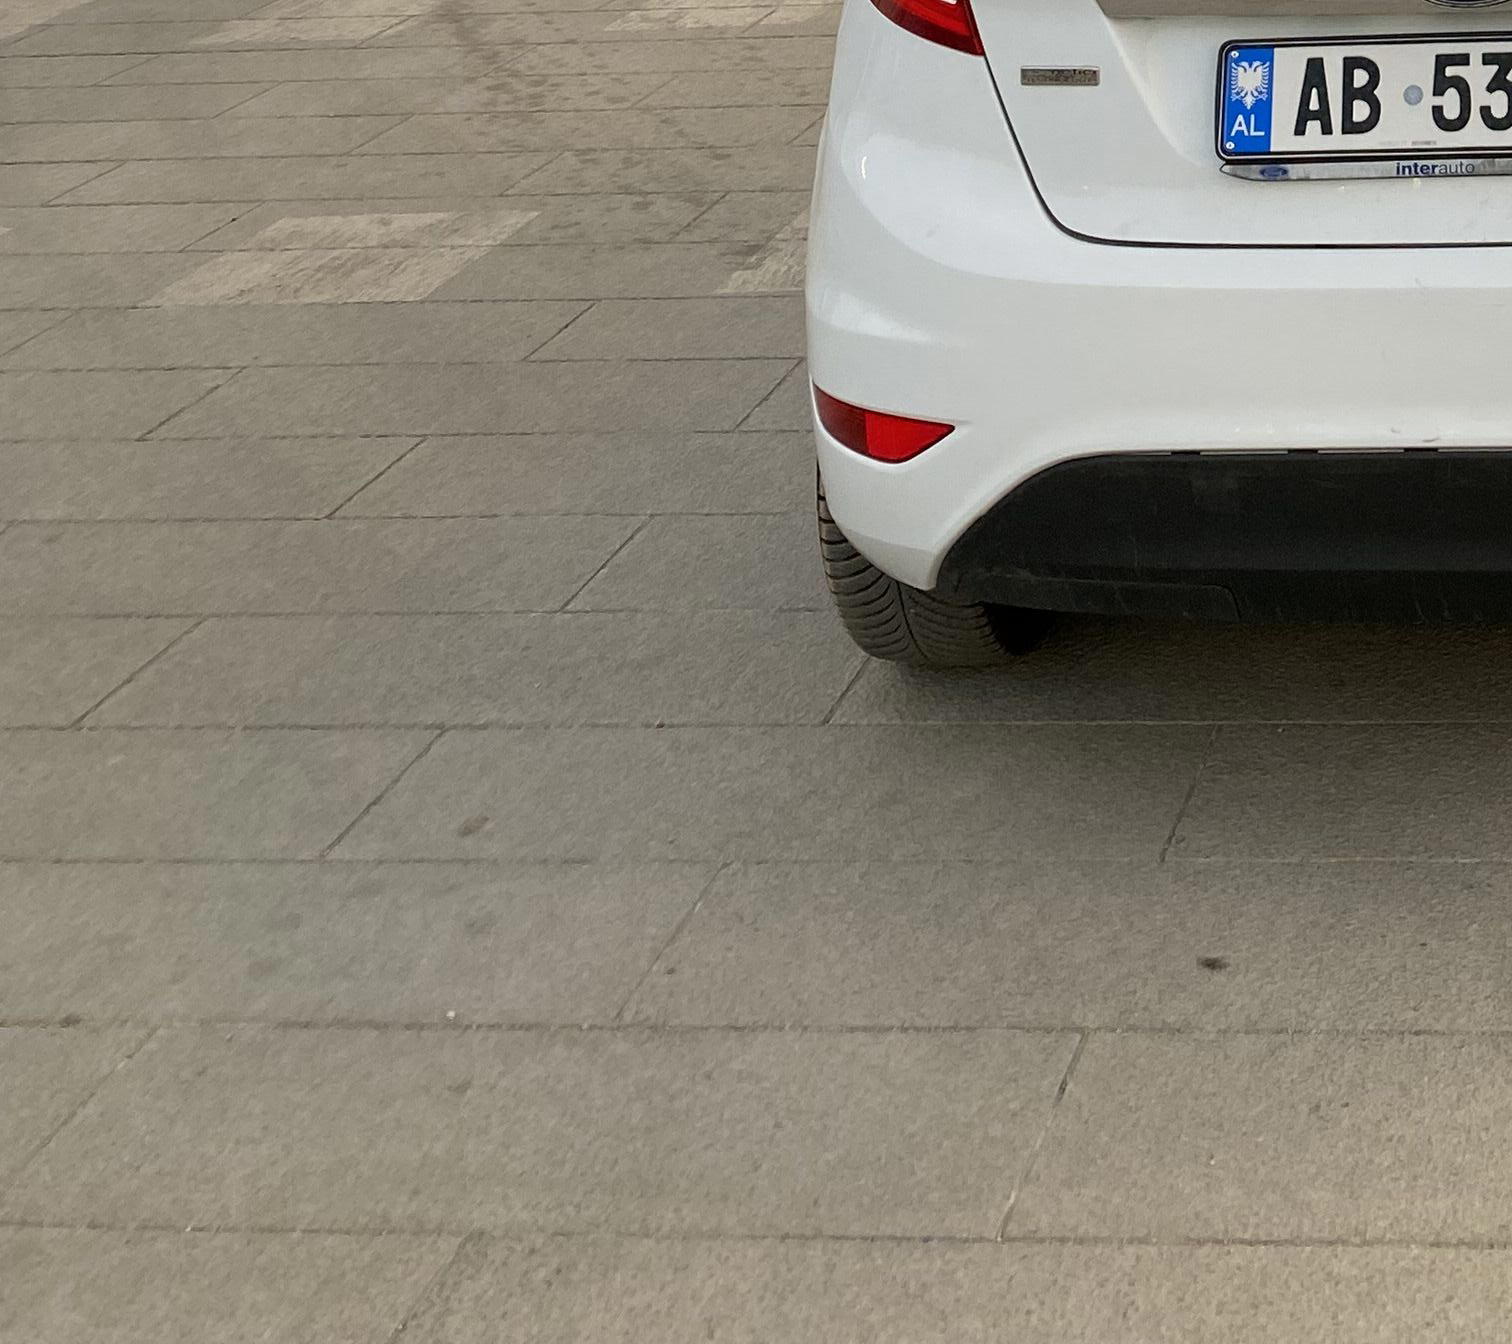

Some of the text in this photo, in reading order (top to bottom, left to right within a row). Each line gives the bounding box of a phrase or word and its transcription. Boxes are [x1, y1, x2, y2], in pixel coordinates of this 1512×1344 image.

[1293, 55, 1382, 136] AB
[1230, 114, 1265, 137] AL
[1395, 161, 1476, 176] interauto
